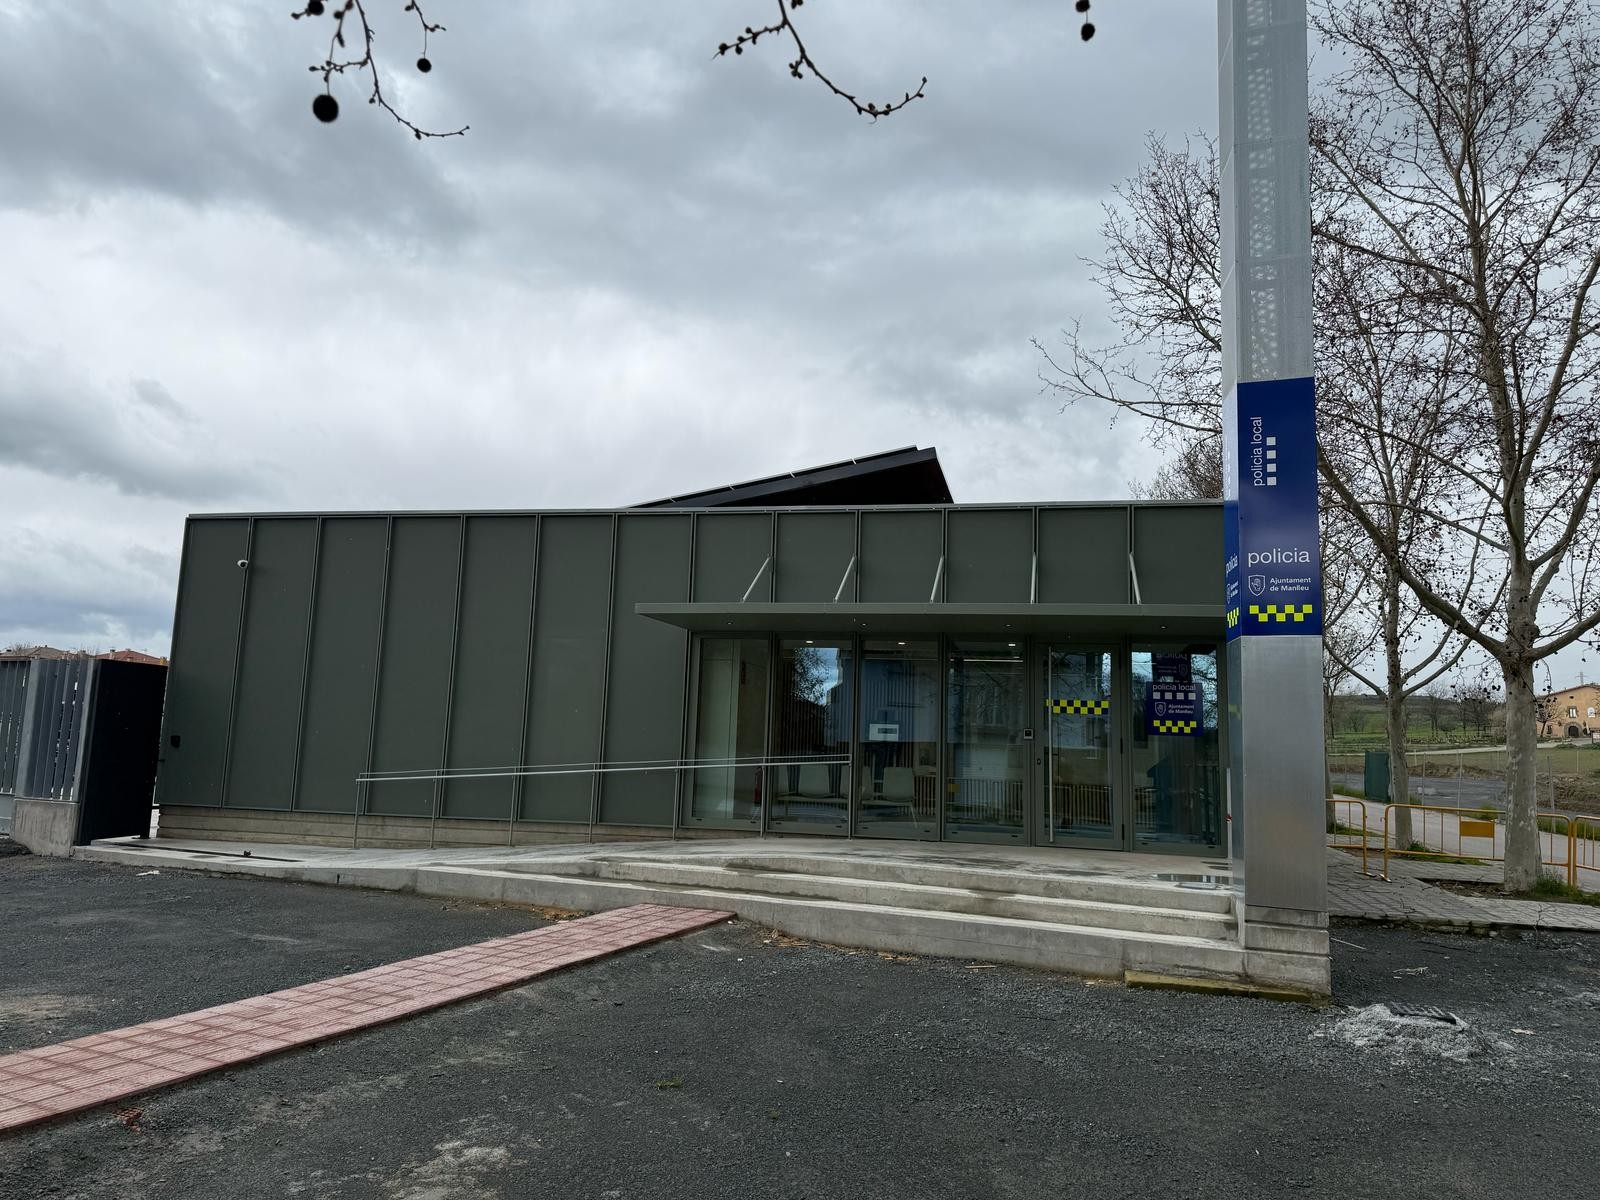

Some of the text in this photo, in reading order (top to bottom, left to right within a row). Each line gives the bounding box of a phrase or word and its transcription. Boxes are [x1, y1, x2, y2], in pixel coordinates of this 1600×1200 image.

[1250, 416, 1266, 486] policia local
[1248, 547, 1310, 567] policia
[1153, 684, 1177, 692] policia
